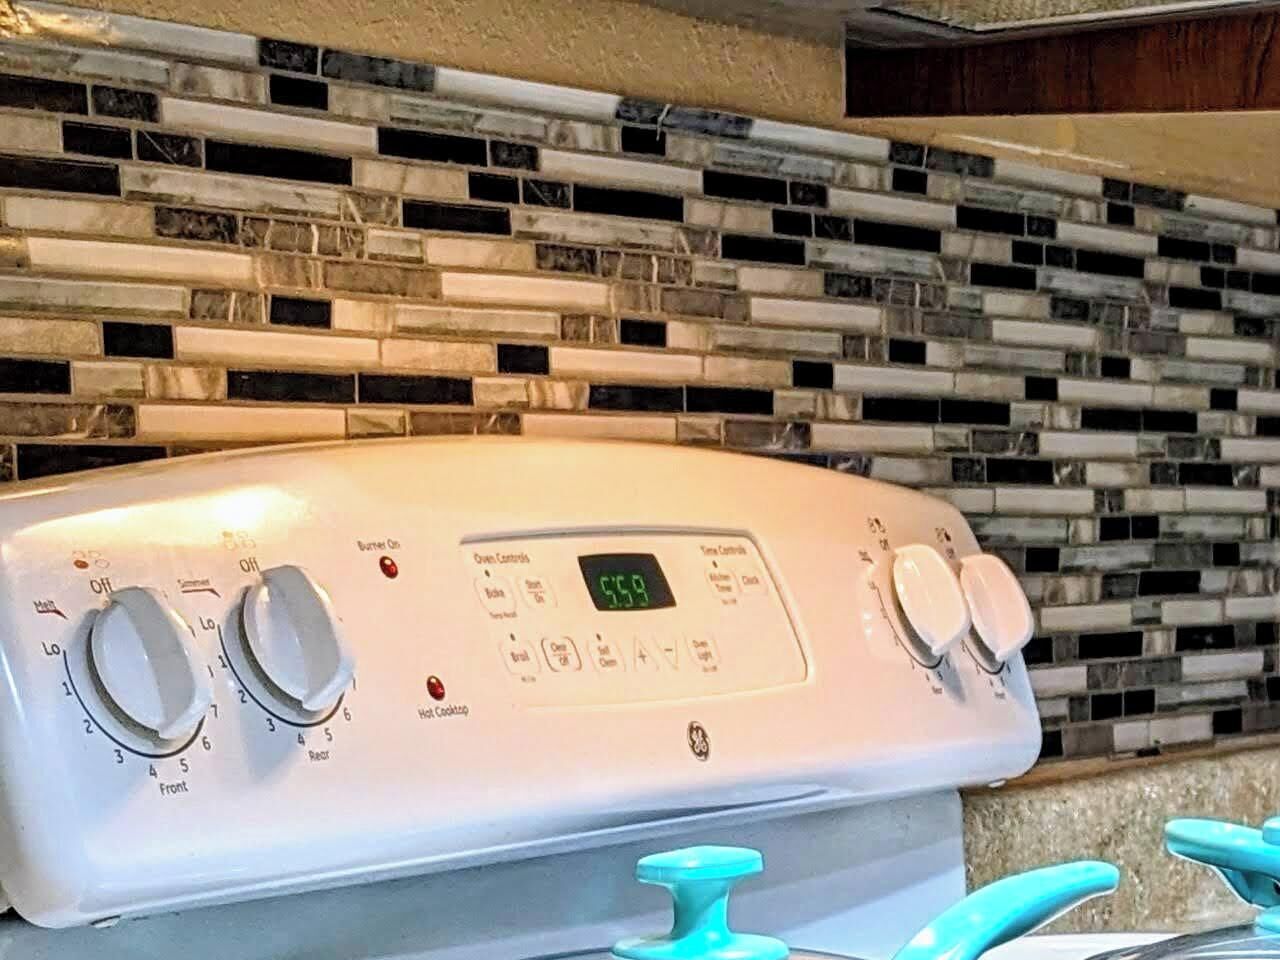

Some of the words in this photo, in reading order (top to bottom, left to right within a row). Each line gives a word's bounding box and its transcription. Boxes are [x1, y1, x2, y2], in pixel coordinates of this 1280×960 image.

[357, 540, 386, 551] Burner
[239, 557, 260, 573] Off
[473, 553, 496, 564] Oven
[496, 552, 530, 564] Controls
[89, 577, 113, 595] Off
[198, 616, 216, 631] Lo
[41, 641, 61, 656] Lo
[62, 681, 73, 696] 1
[237, 689, 248, 704] 2
[210, 703, 219, 719] 7
[343, 707, 352, 722] 6
[417, 708, 435, 720] Hot
[435, 704, 470, 719] Cooktop
[83, 719, 94, 734] 2
[266, 718, 277, 733] 3
[324, 727, 334, 742] 5
[202, 736, 212, 751] 6
[114, 749, 125, 764] 3
[308, 750, 331, 763] Rear
[149, 765, 158, 779] 4
[179, 758, 189, 773] 5
[159, 780, 190, 797] Front
